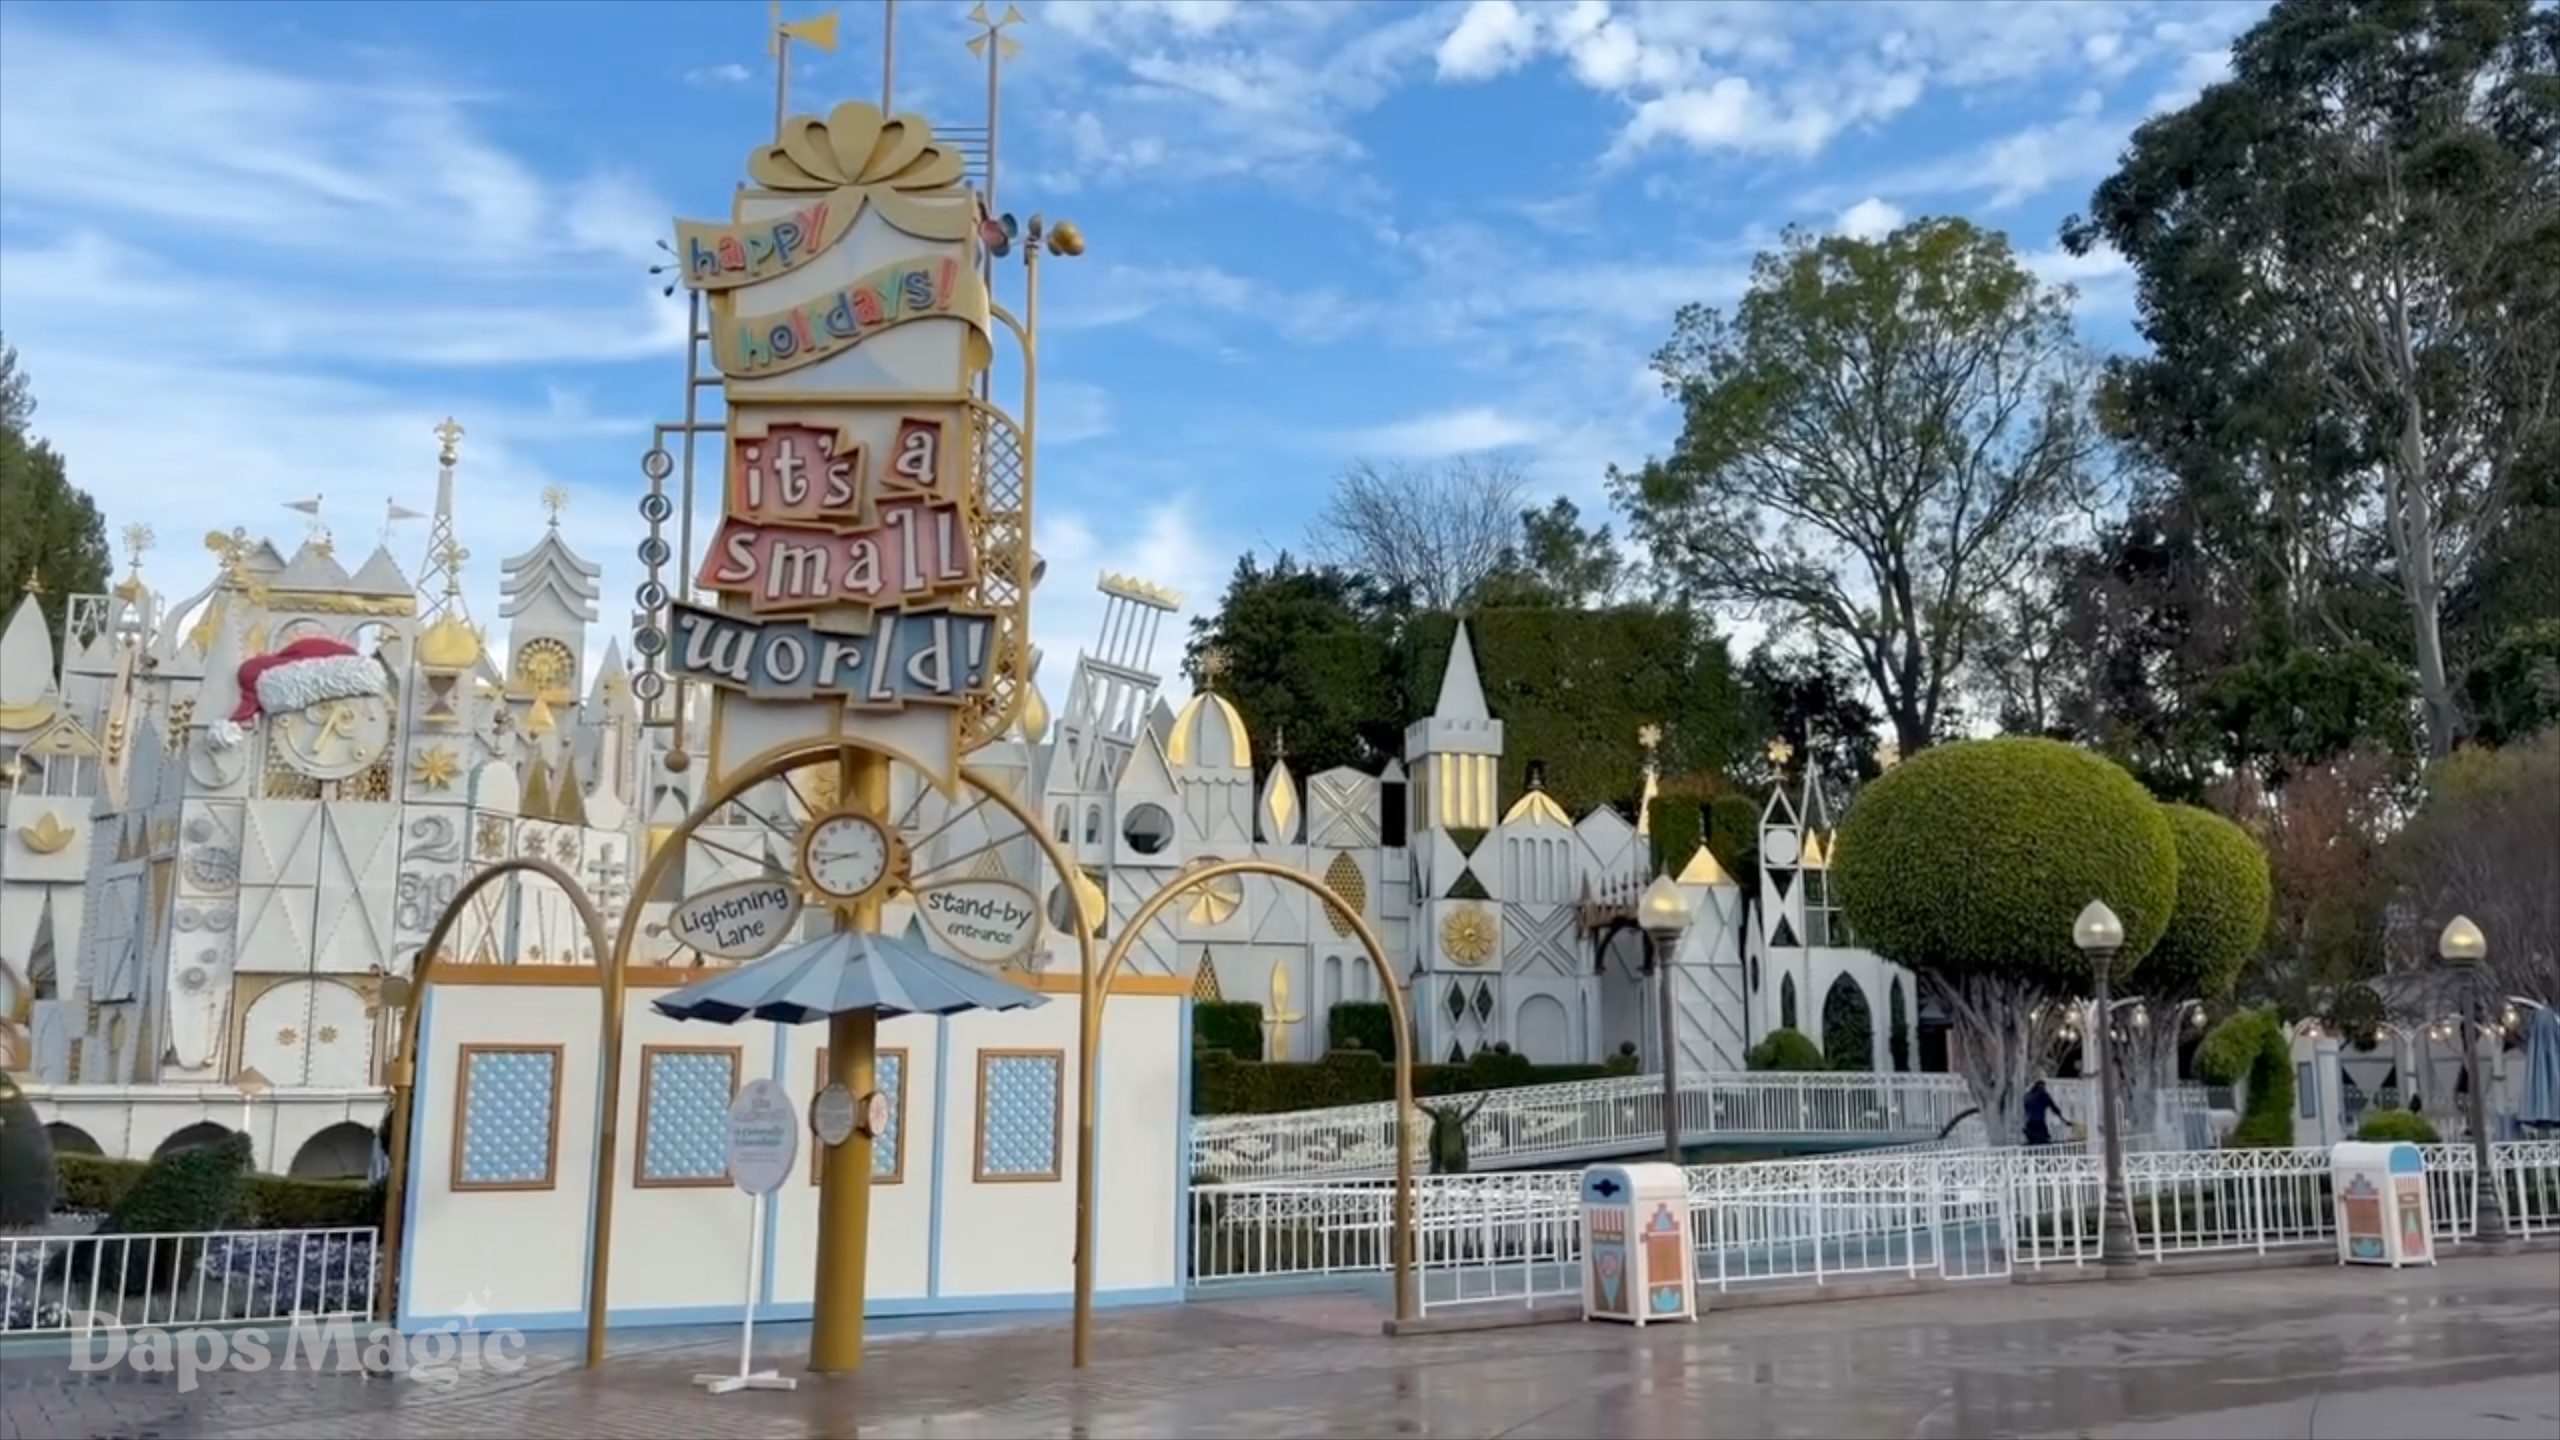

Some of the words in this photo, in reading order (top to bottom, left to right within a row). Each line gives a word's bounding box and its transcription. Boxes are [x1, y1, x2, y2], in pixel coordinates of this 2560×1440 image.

[691, 201, 829, 281] happy
[738, 256, 959, 370] holidays!
[746, 434, 852, 508] it's
[896, 429, 936, 486] a
[716, 507, 965, 600] small
[680, 614, 987, 700] world!
[680, 887, 789, 934] Lightning
[715, 920, 765, 949] Lane
[928, 891, 1033, 931] stand-by
[947, 922, 1014, 945] entrance
